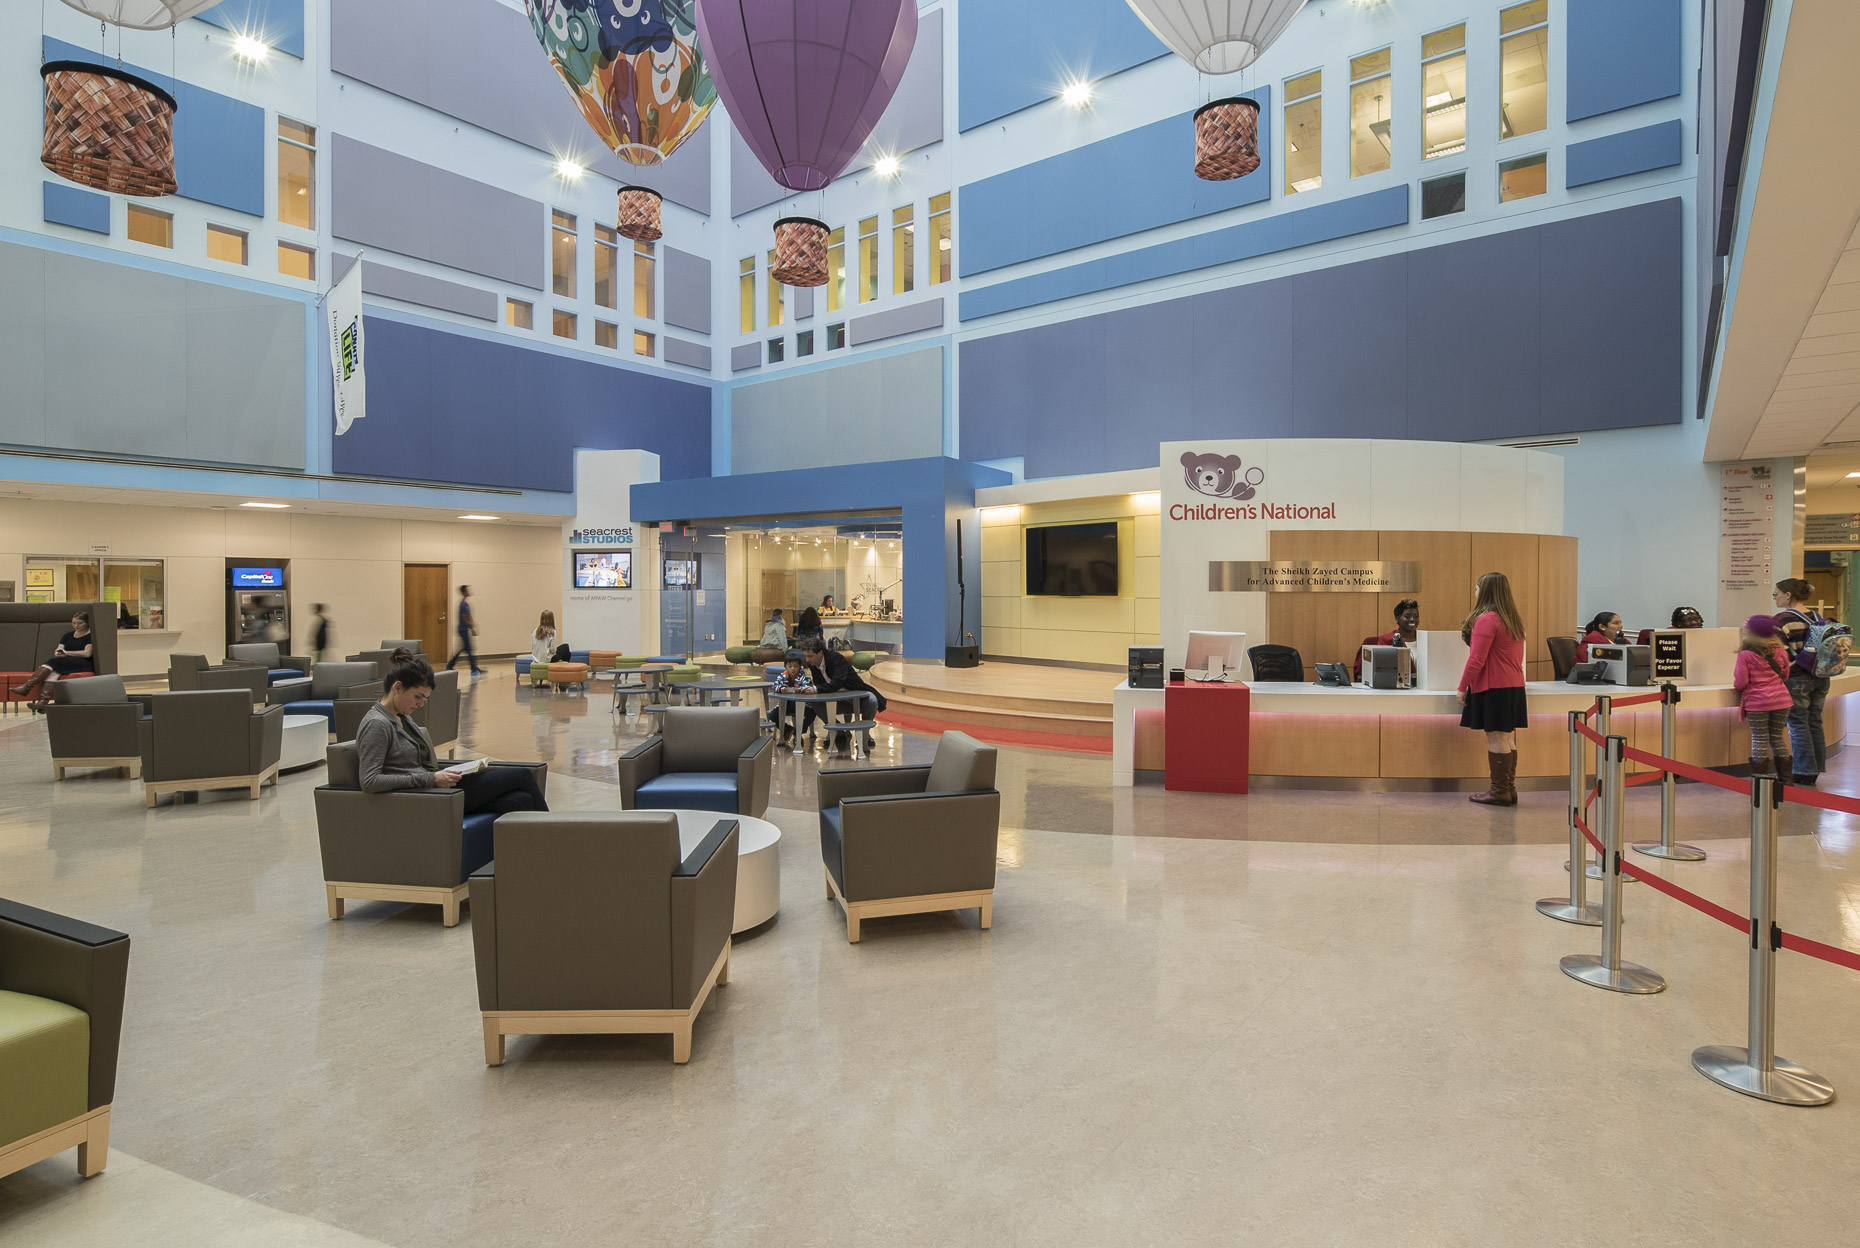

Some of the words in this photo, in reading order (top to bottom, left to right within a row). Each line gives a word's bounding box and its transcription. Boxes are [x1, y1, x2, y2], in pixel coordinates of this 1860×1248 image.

[1169, 503, 1257, 521] Children's
[1261, 502, 1337, 520] National
[582, 527, 633, 536] seacrest
[582, 535, 634, 544] STUDIOS
[1262, 567, 1279, 575] The
[1281, 567, 1310, 575] Sheikh
[1312, 567, 1338, 577] Zayed
[1340, 567, 1374, 577] Campus
[1247, 577, 1260, 585] for
[1262, 577, 1304, 585] Advanced
[1306, 577, 1351, 585] Children's
[1353, 577, 1390, 585] Medicine
